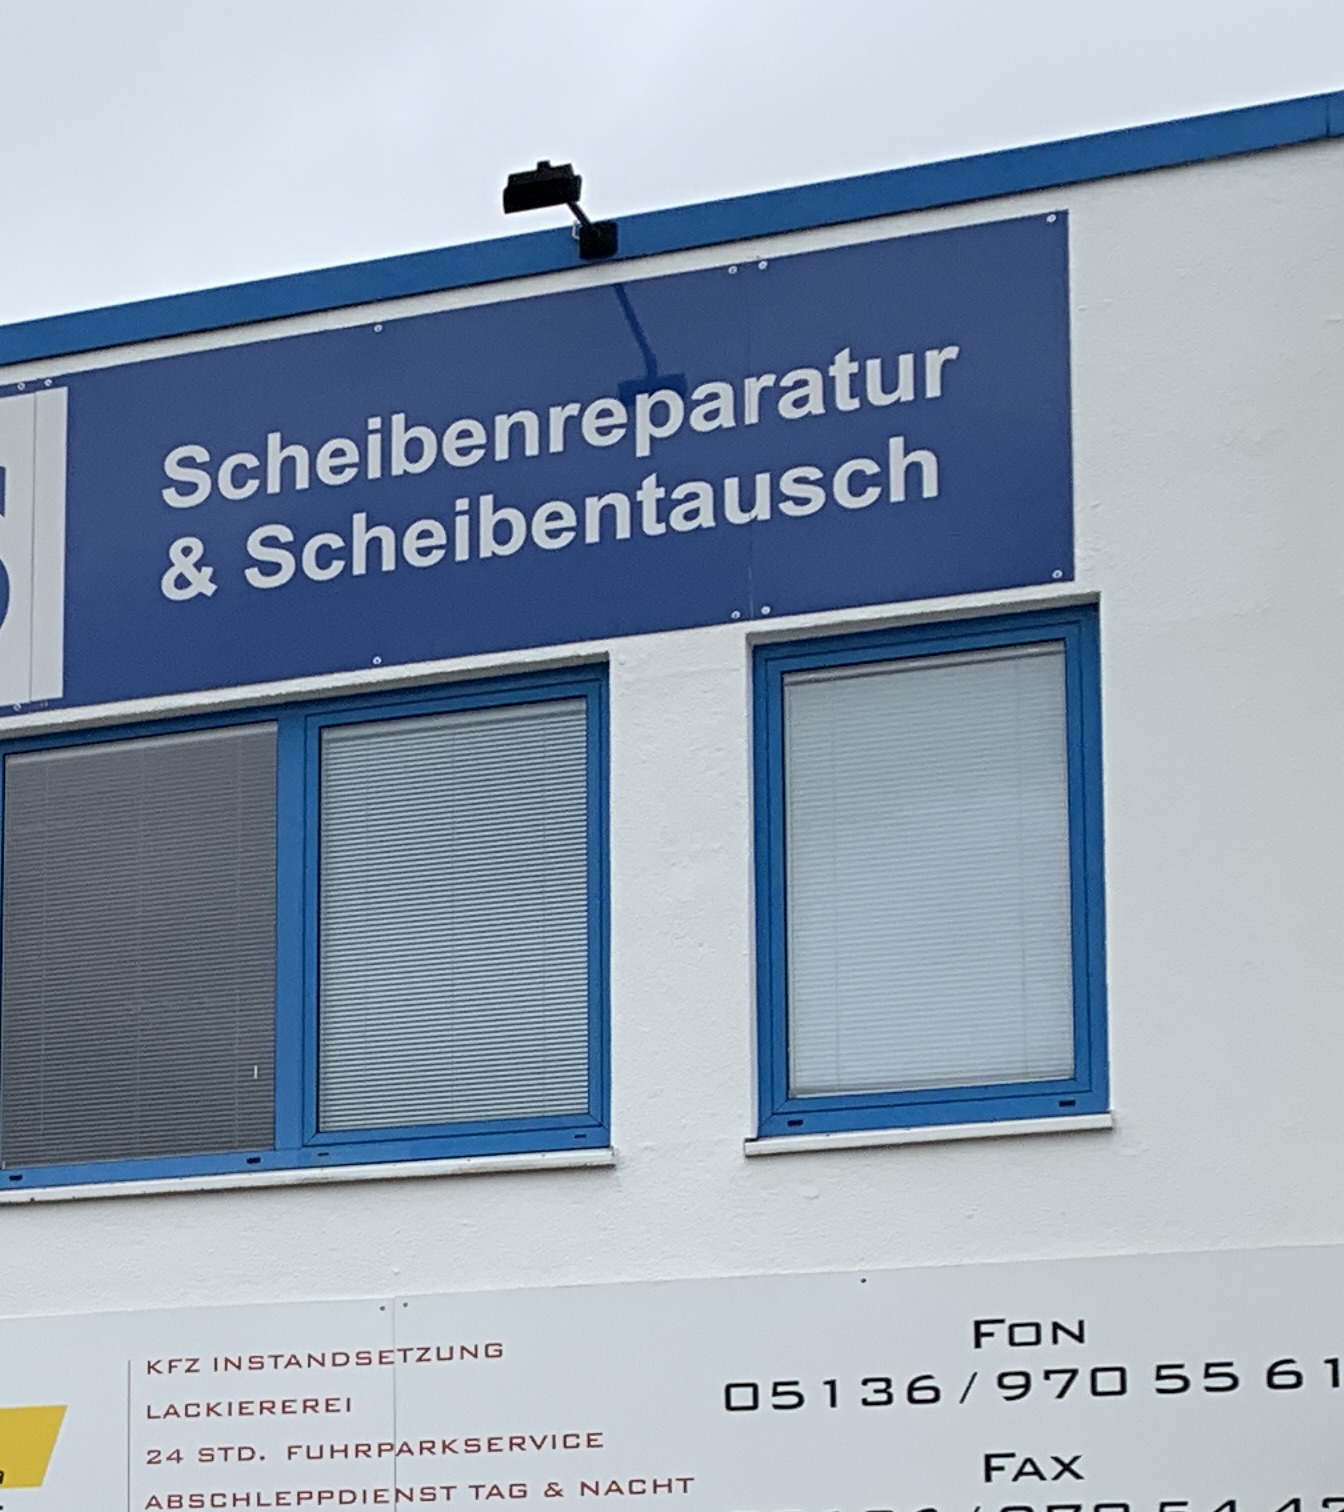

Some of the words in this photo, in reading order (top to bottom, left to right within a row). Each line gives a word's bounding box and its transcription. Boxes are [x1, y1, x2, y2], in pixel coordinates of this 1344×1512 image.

[161, 344, 961, 510] Scheibenreparatur
[161, 536, 219, 602] &
[243, 435, 940, 590] Scheibentausch
[146, 1357, 201, 1375] KFZ
[213, 1342, 504, 1372] INSTANDSETZUNG
[1154, 1360, 1240, 1394] 55
[1266, 1357, 1343, 1390] 61
[146, 1397, 353, 1419] LACKIEREREI
[146, 1448, 185, 1465] 24
[198, 1445, 267, 1464] STD.
[287, 1432, 605, 1461] FUHRPARKSERVICE
[983, 1451, 1086, 1483] FAX
[144, 1484, 457, 1510] ABSCHLEPPDIENST
[469, 1482, 529, 1500] TAG
[544, 1481, 564, 1498] &
[579, 1477, 695, 1497] NACHT
